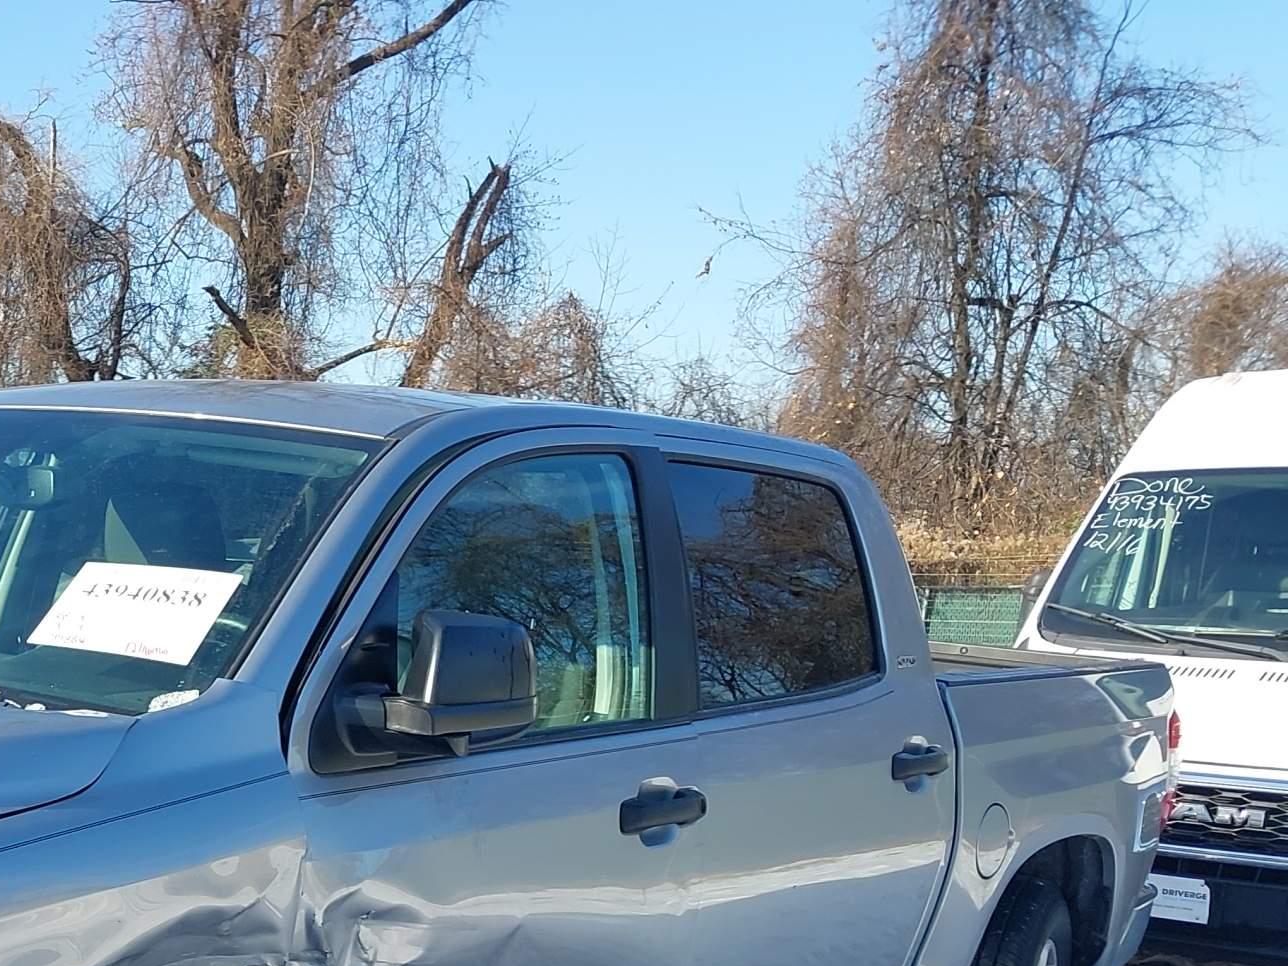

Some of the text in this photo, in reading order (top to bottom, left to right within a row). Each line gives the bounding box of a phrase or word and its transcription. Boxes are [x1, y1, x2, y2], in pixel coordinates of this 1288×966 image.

[1111, 477, 1205, 497] Done
[1107, 494, 1214, 512] 43934175
[1090, 511, 1184, 530] Element
[1083, 530, 1143, 556] 12/16
[82, 583, 208, 608] 43940838
[1168, 802, 1266, 829] AM
[1161, 888, 1208, 901] DRIVERGE
